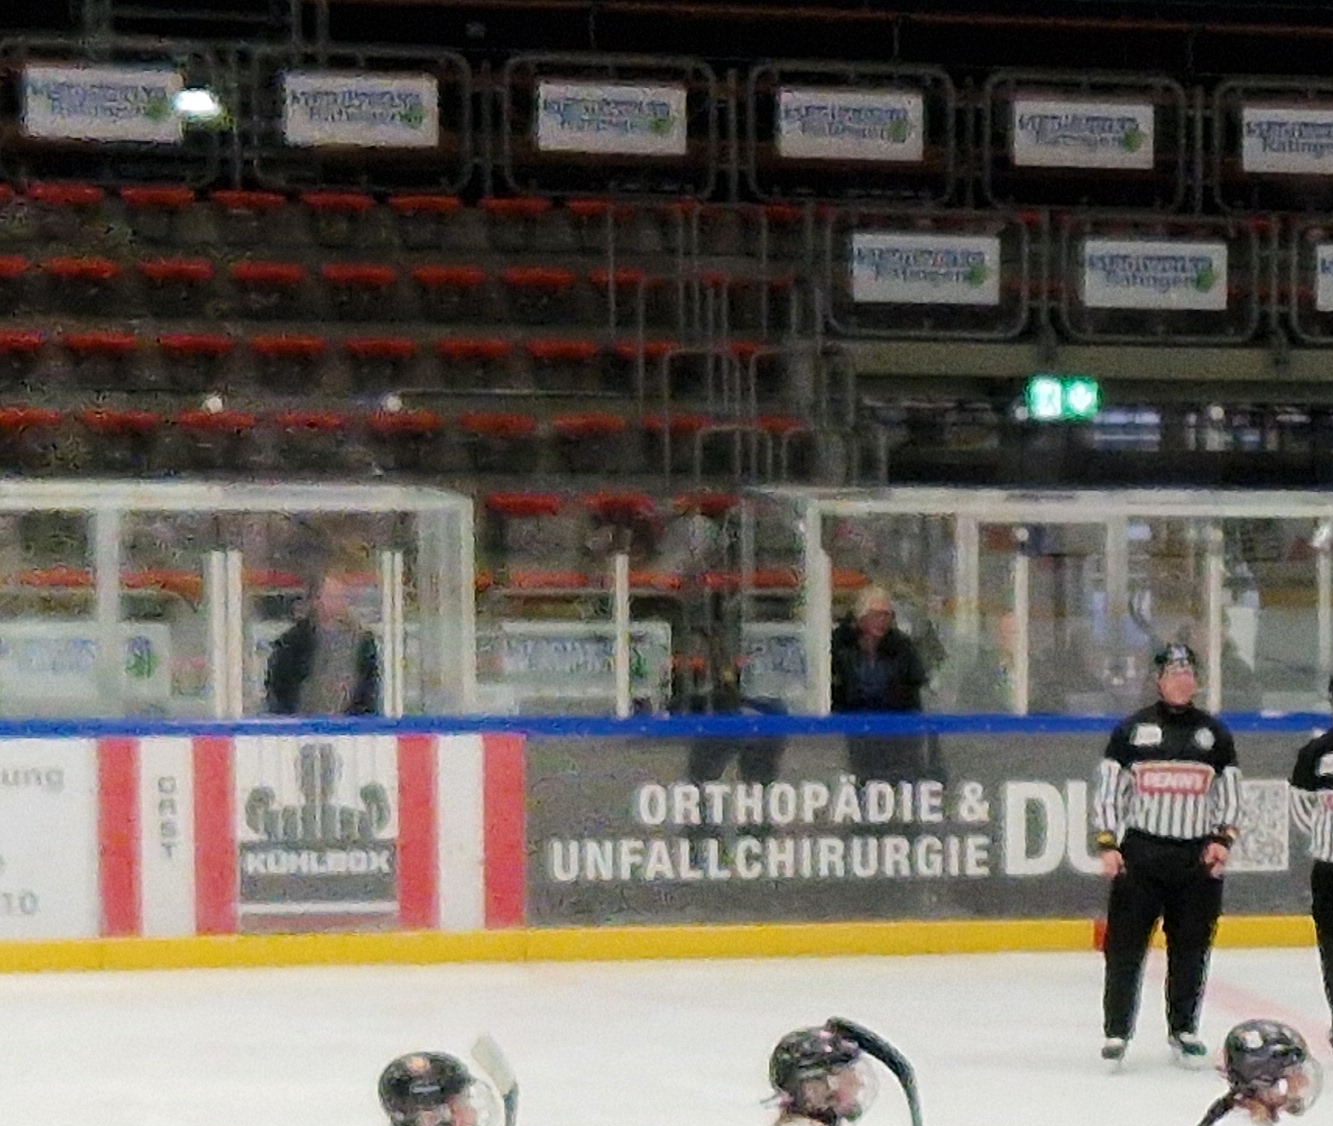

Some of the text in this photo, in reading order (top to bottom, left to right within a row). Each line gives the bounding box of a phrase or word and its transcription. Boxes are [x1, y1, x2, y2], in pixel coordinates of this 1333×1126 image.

[638, 774, 990, 826] ORTHOPÄDIE &
[550, 833, 992, 882] UNFALLCHIRURGIE
